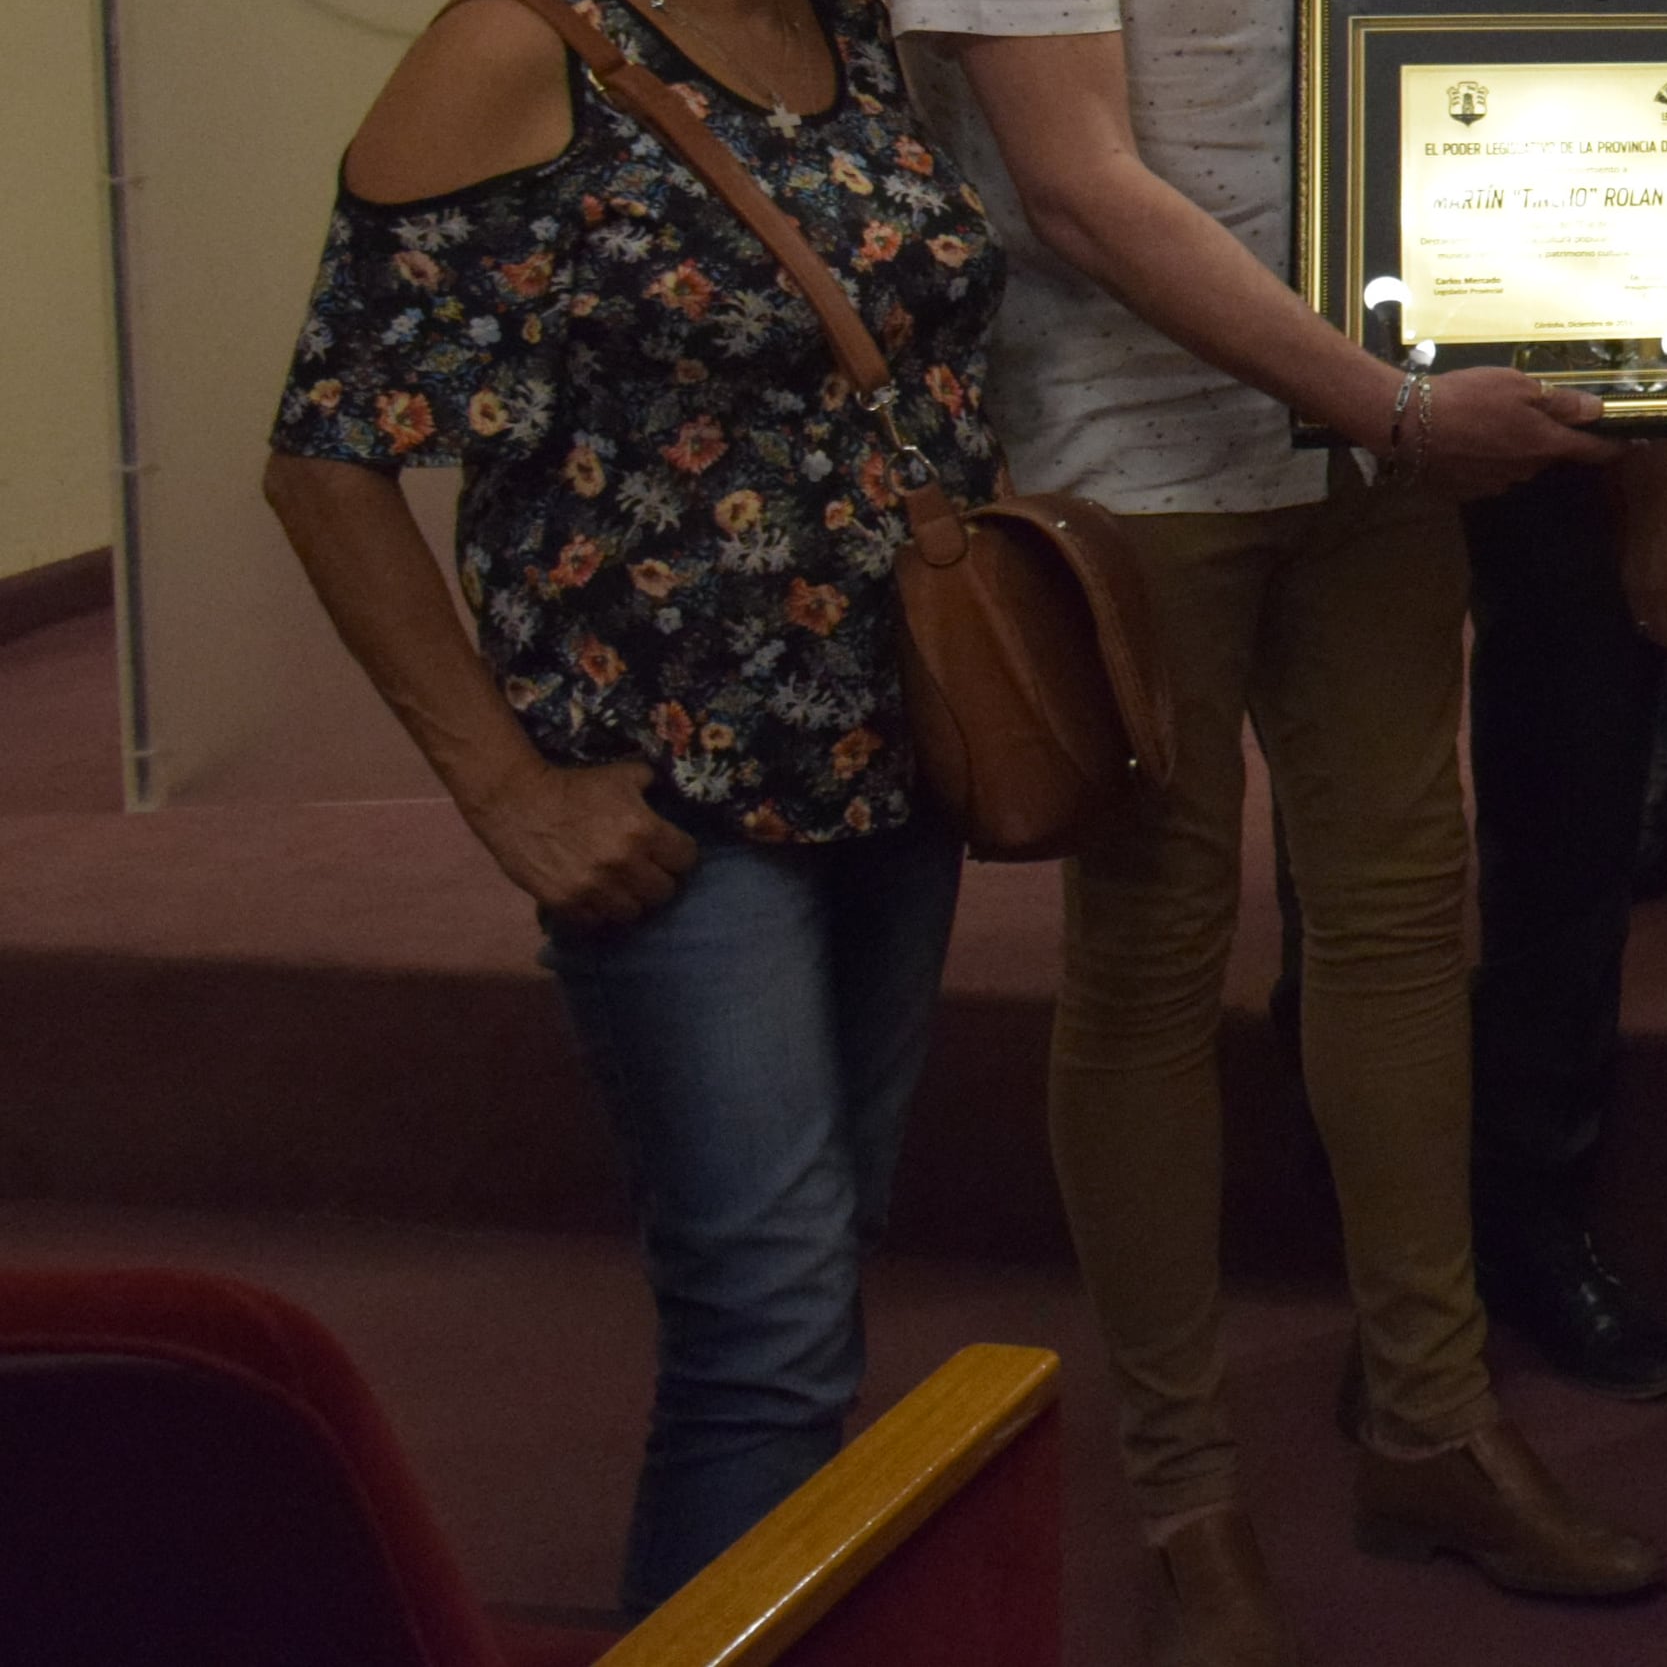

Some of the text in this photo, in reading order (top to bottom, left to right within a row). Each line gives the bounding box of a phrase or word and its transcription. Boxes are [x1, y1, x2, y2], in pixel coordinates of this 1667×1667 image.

[1425, 143, 1439, 156] EL
[1442, 142, 1481, 156] PODER
[1560, 141, 1574, 154] DE
[1579, 141, 1593, 154] LA
[1597, 140, 1657, 154] PROVINCIA
[1604, 186, 1663, 208] ROLAN
[1435, 276, 1502, 286] Carlos Mercado
